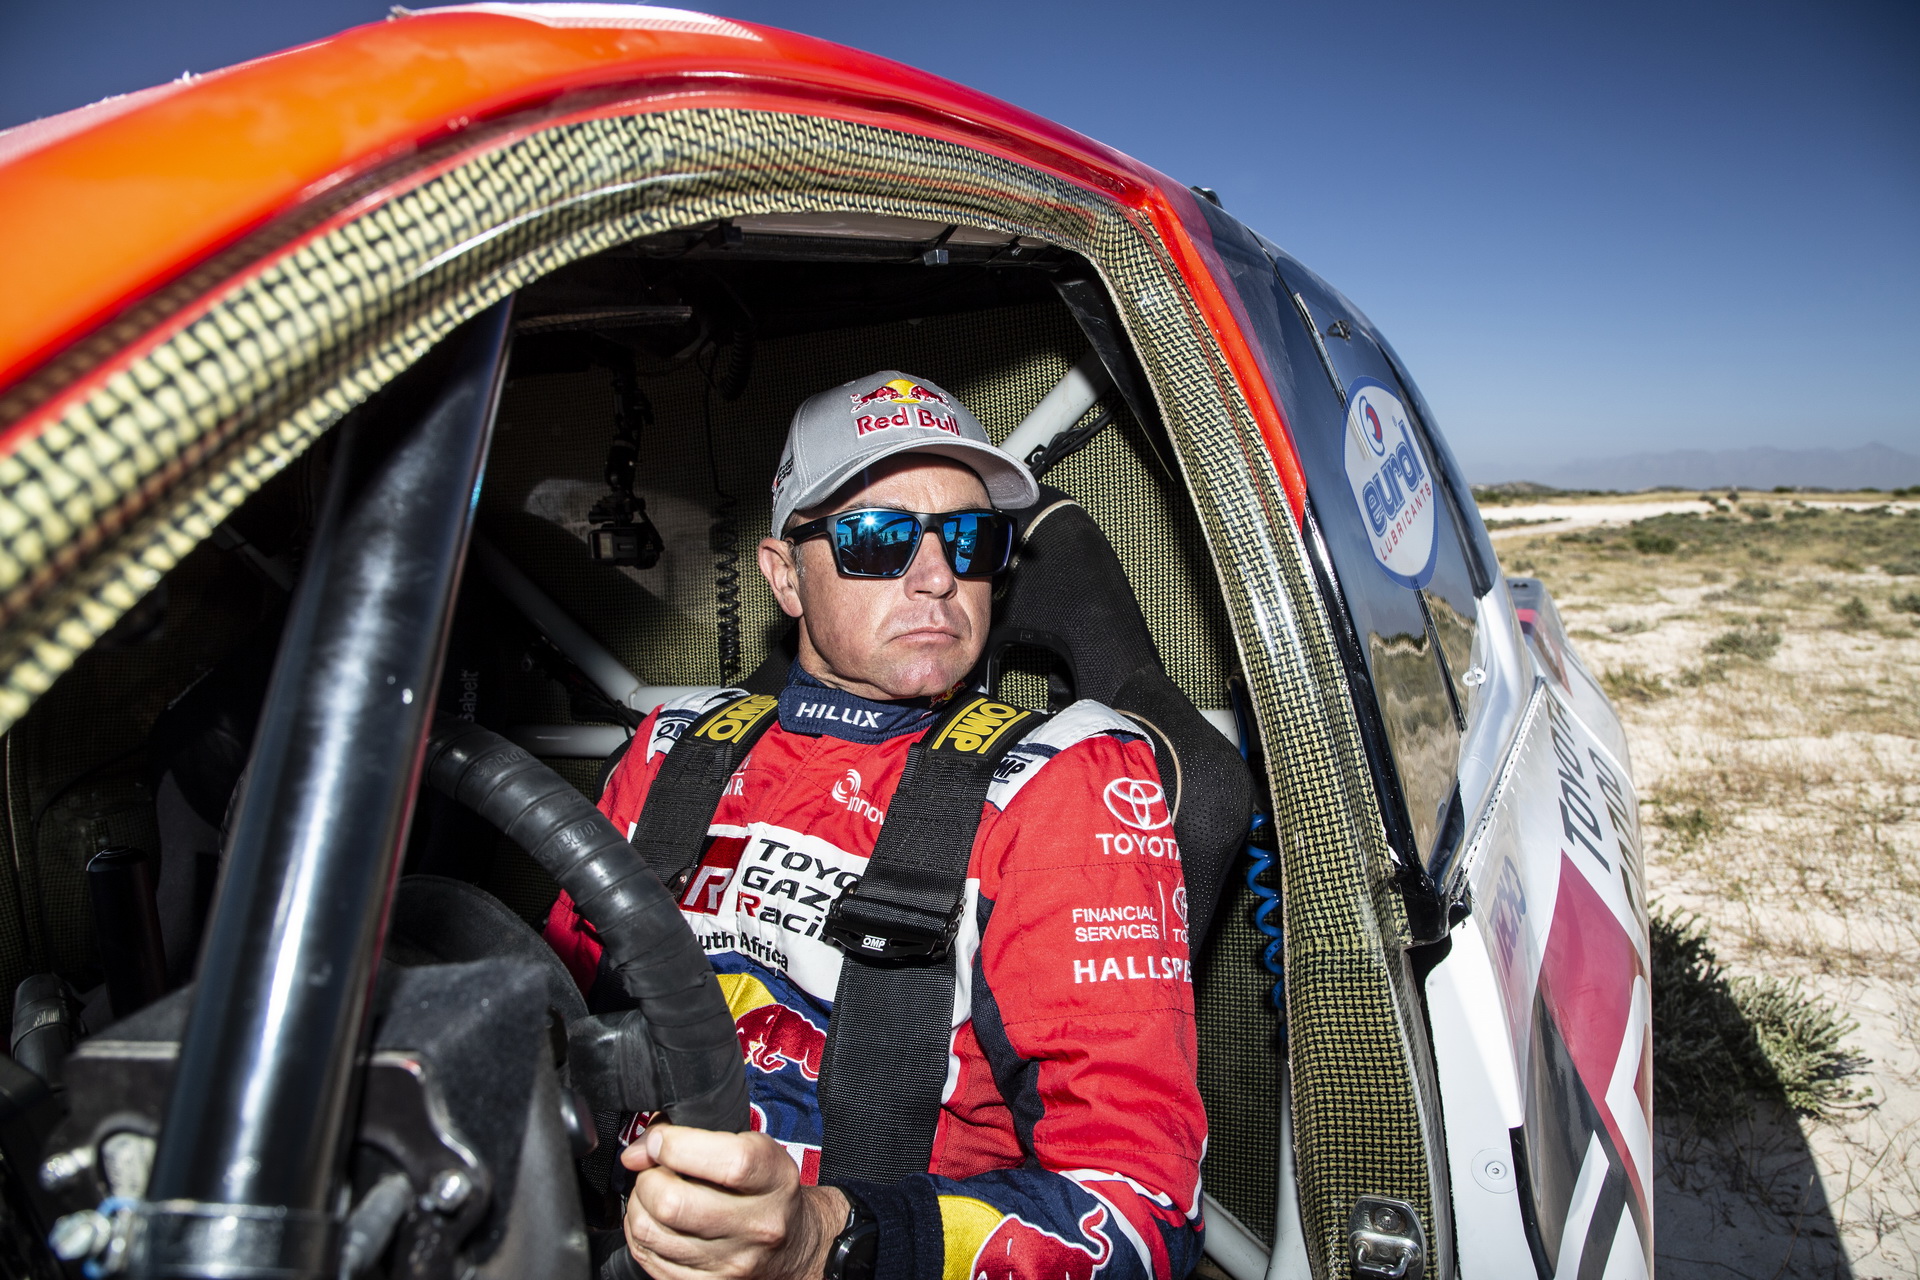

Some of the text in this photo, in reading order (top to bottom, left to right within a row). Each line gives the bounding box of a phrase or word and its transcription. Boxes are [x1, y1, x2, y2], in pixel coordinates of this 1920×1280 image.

[857, 407, 961, 438] Red Bull
[1362, 419, 1424, 538] eurol
[1379, 482, 1432, 562] LUBRICANTS
[796, 702, 883, 728] HILUX
[947, 702, 1017, 752] OMP
[1546, 694, 1611, 875] TOYOTA
[741, 866, 832, 912] GAZ
[736, 891, 838, 945] Raci
[1072, 905, 1158, 923] FINANCIAL
[1075, 924, 1160, 943] SERVICES
[741, 931, 788, 972] Africa
[863, 937, 886, 949] OMP
